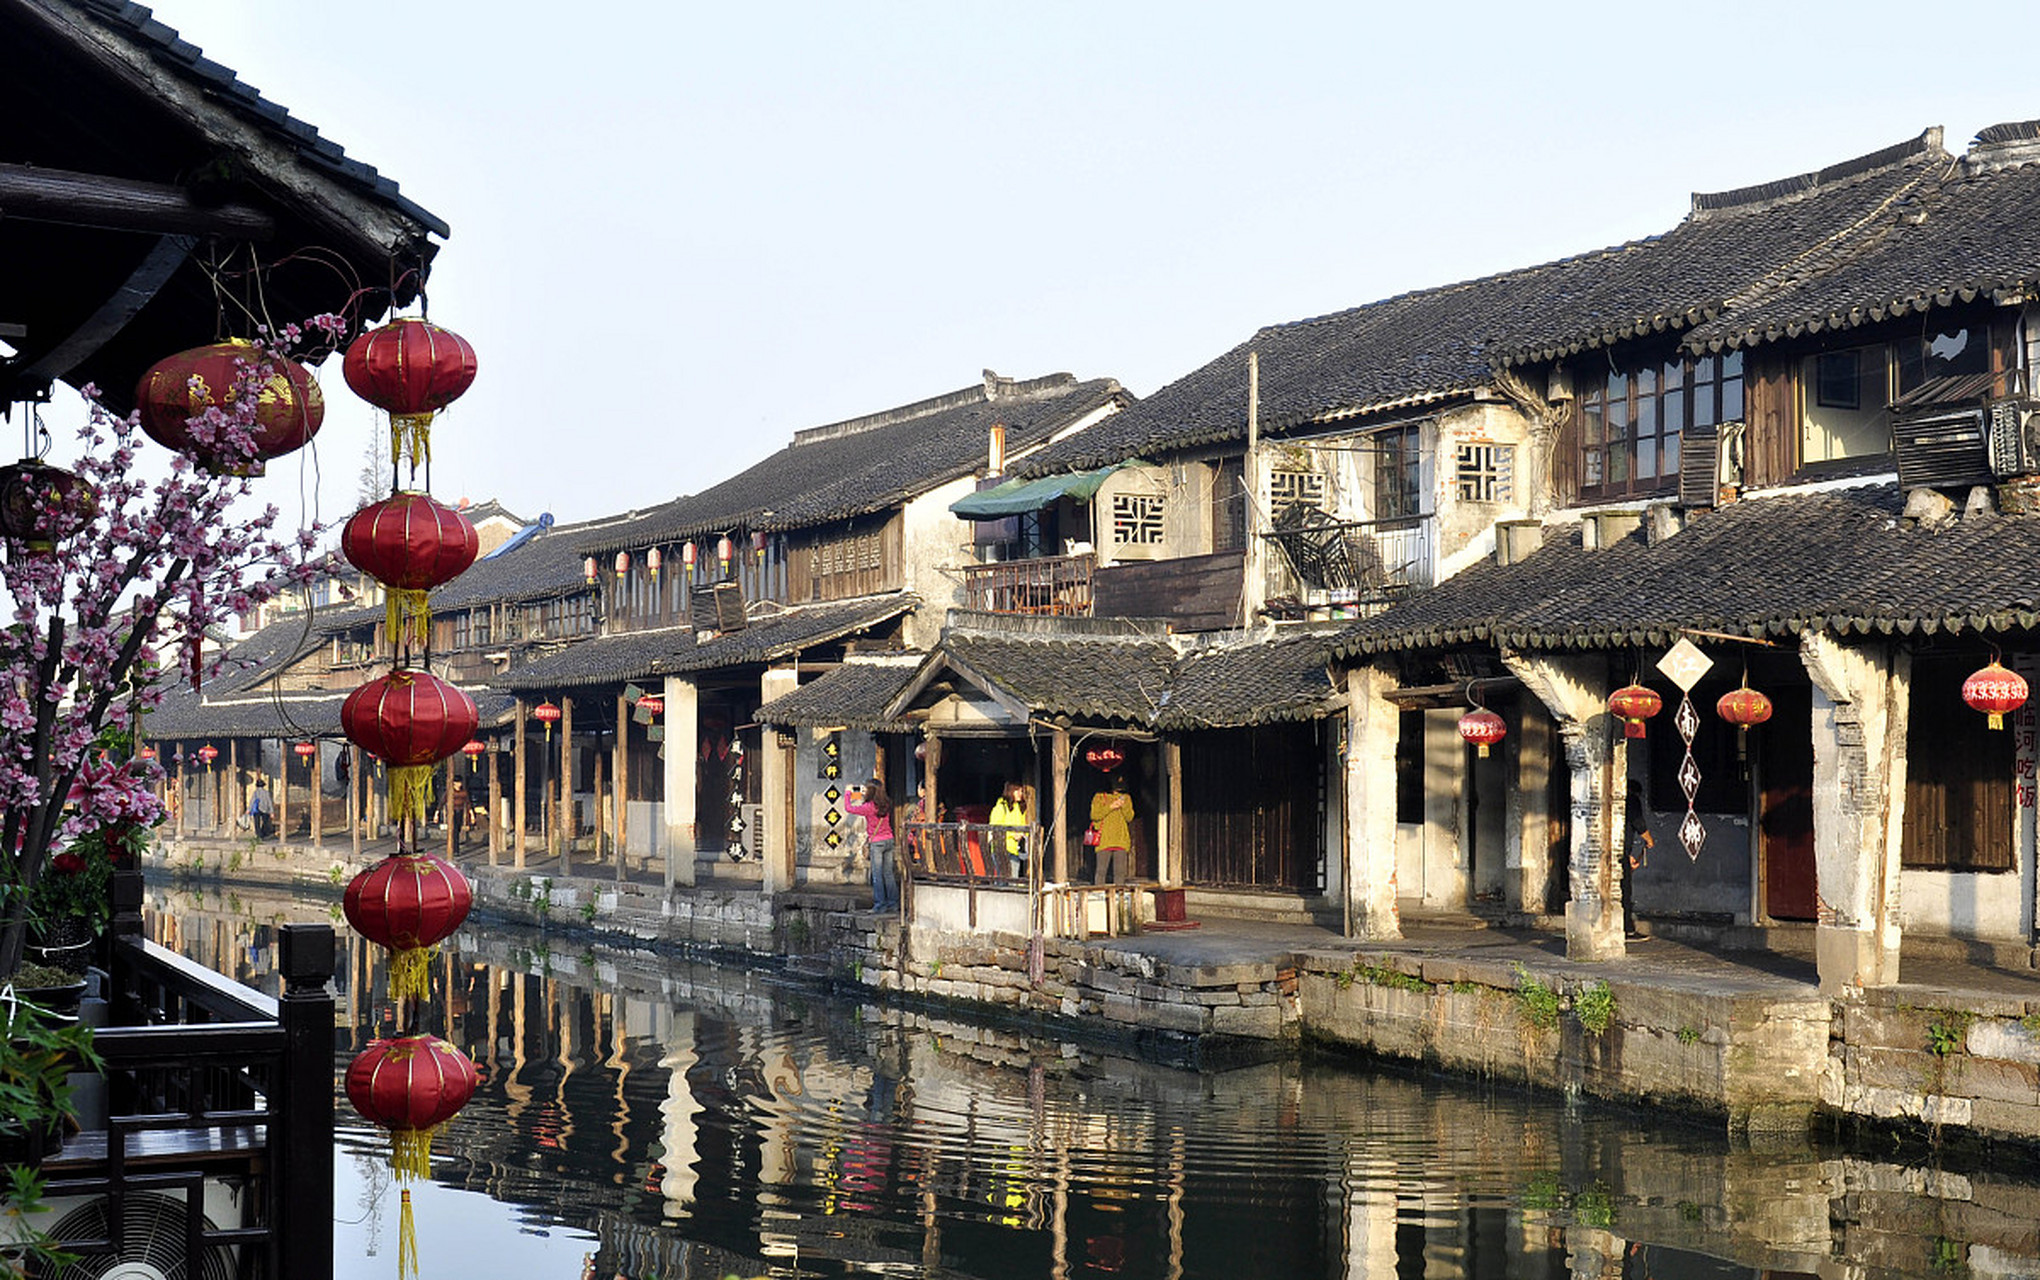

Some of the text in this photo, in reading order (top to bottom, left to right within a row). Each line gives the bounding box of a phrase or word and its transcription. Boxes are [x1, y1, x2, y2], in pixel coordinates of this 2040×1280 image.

[2015, 656, 2036, 808] 二临河吃饭
